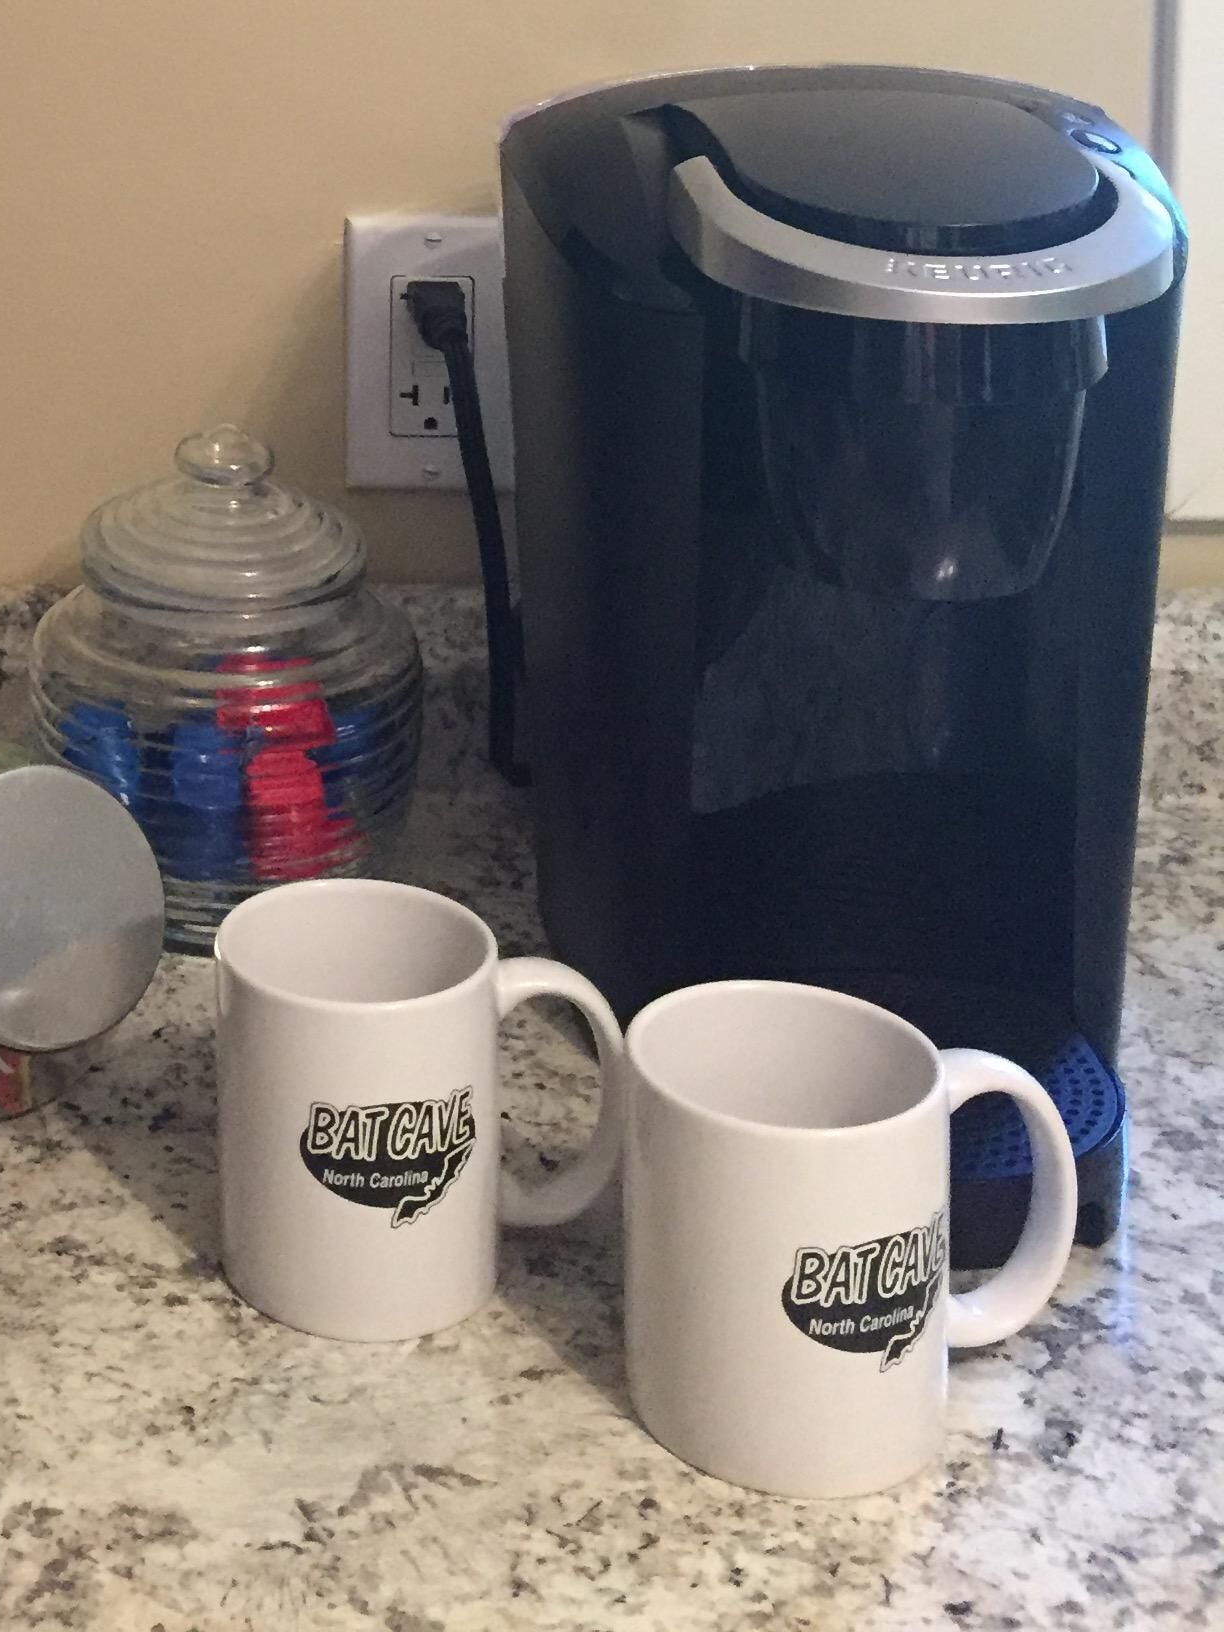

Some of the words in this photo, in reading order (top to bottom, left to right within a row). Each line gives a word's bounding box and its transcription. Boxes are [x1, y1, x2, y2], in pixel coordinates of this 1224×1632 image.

[308, 1102, 389, 1161] BAT
[388, 1085, 473, 1160] CAVE
[322, 1169, 365, 1188] North
[369, 1170, 429, 1189] Carolina
[792, 1243, 880, 1308] BAT
[809, 1318, 855, 1337] North
[860, 1305, 914, 1334] Carolina
